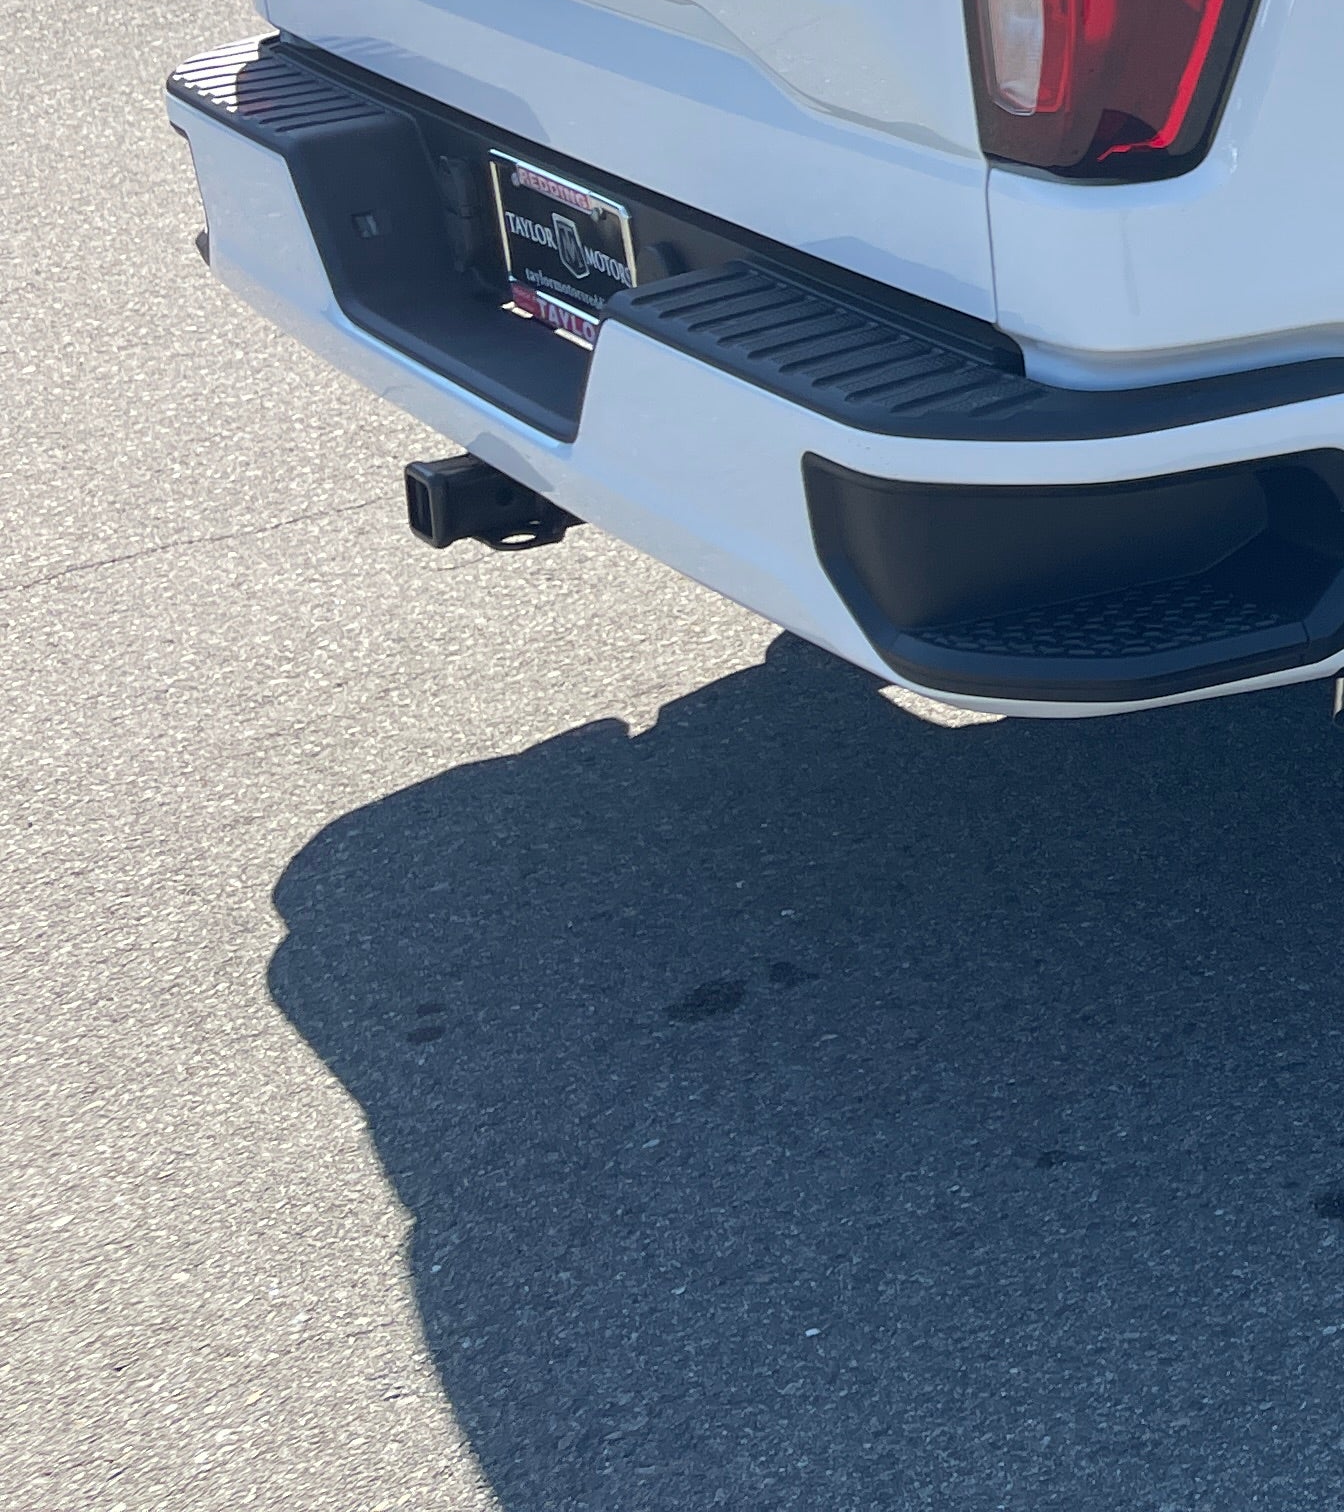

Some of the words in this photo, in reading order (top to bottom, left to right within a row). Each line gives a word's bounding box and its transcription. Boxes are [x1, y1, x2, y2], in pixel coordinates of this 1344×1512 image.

[518, 167, 592, 211] REDDING
[505, 211, 558, 251] TAYLOR
[583, 244, 633, 288] MOTORS
[535, 294, 596, 342] TAYLO
